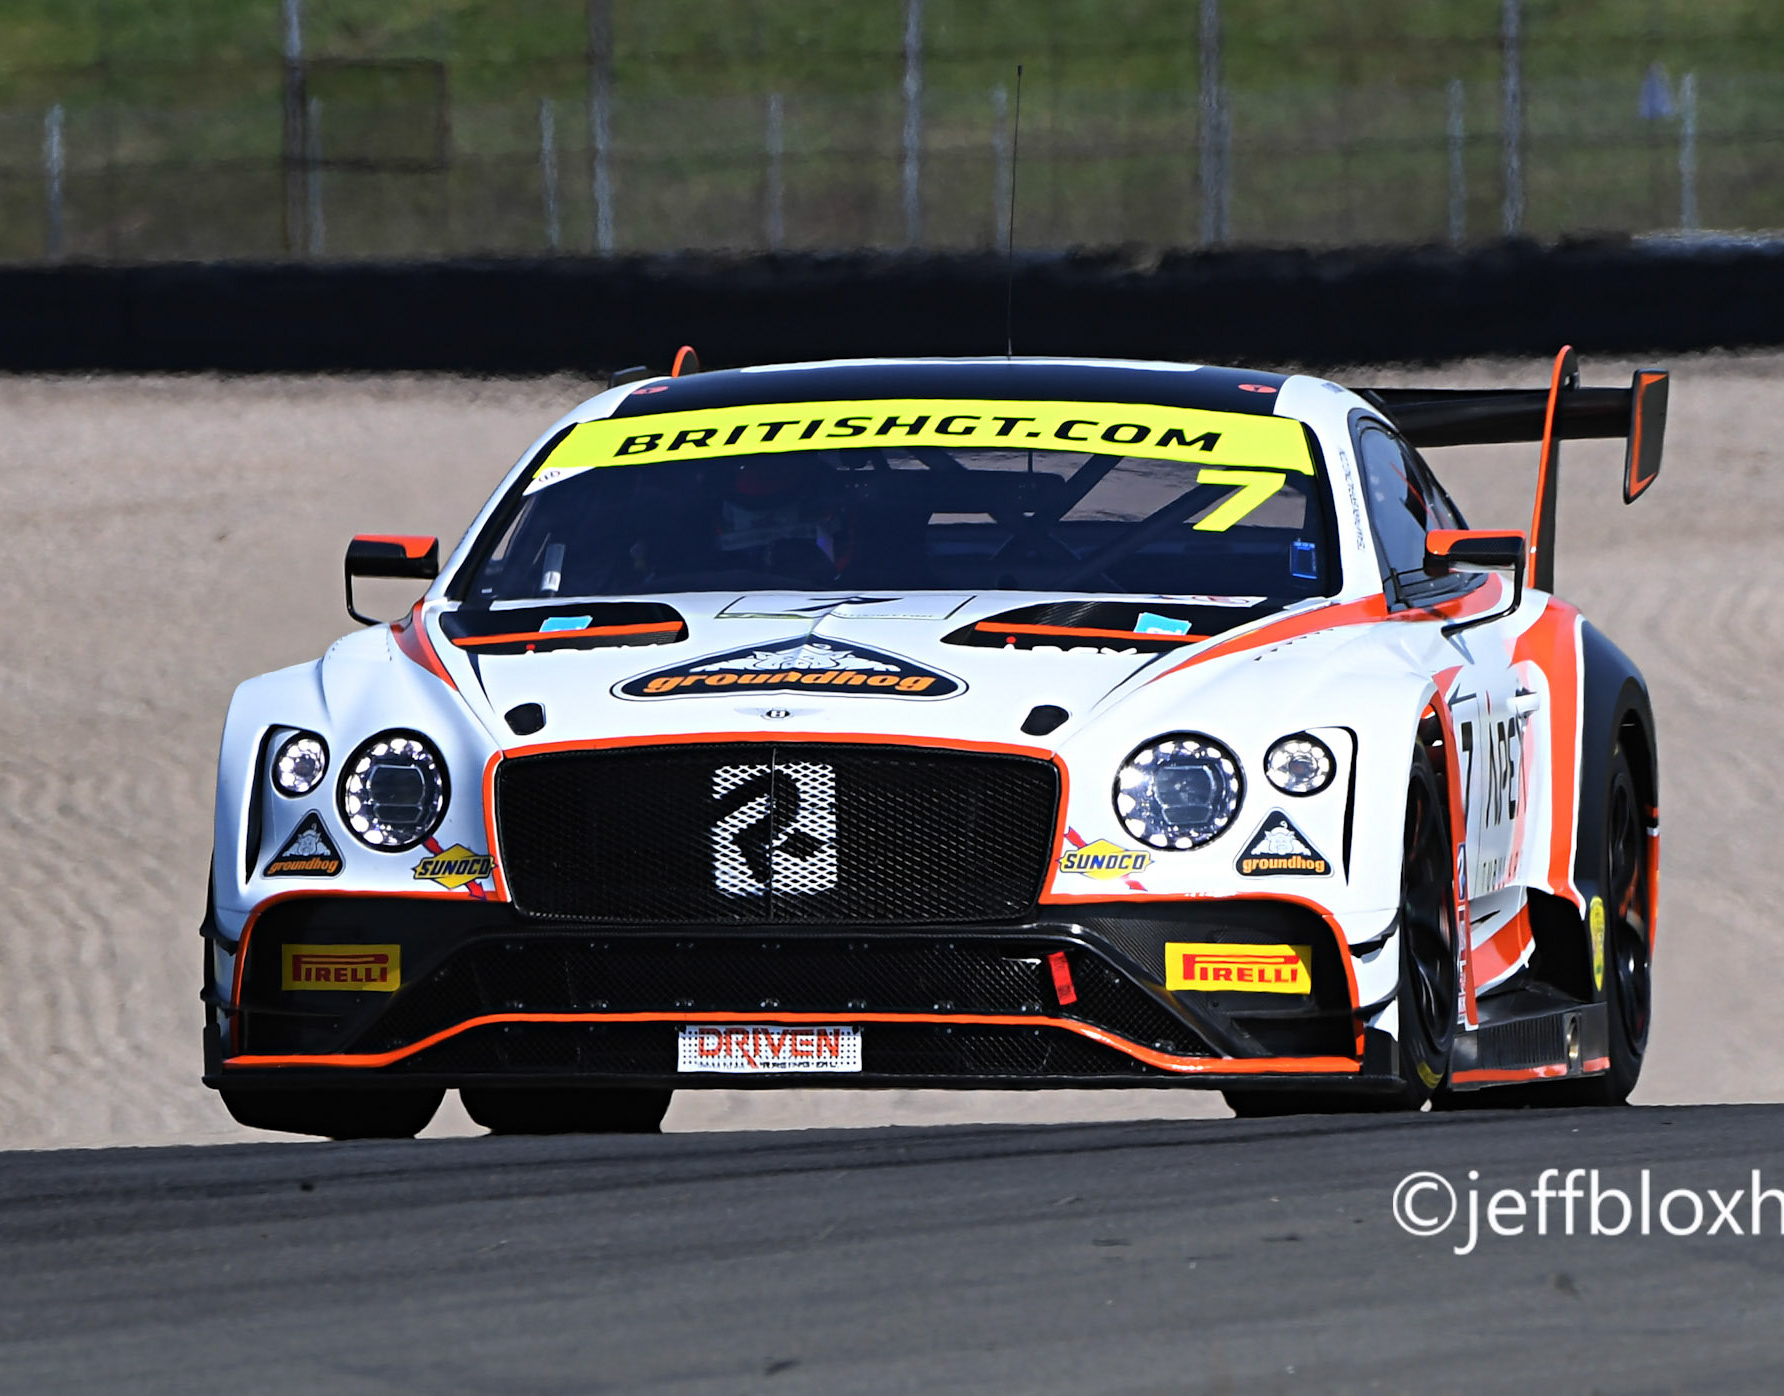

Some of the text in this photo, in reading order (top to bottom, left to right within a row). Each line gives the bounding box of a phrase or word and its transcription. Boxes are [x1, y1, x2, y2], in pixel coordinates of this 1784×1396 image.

[613, 415, 1220, 456] BRITISHGT.COM
[1193, 468, 1287, 532] 7
[643, 670, 937, 694] groundhog
[267, 855, 340, 875] groundhog
[417, 857, 491, 877] SUNOCO
[1064, 853, 1146, 871] SUNOCO
[1242, 855, 1326, 873] groundhog
[292, 953, 389, 983] PIRELLI
[1182, 953, 1300, 983] PIRELLI
[697, 1027, 841, 1068] DRIVEN
